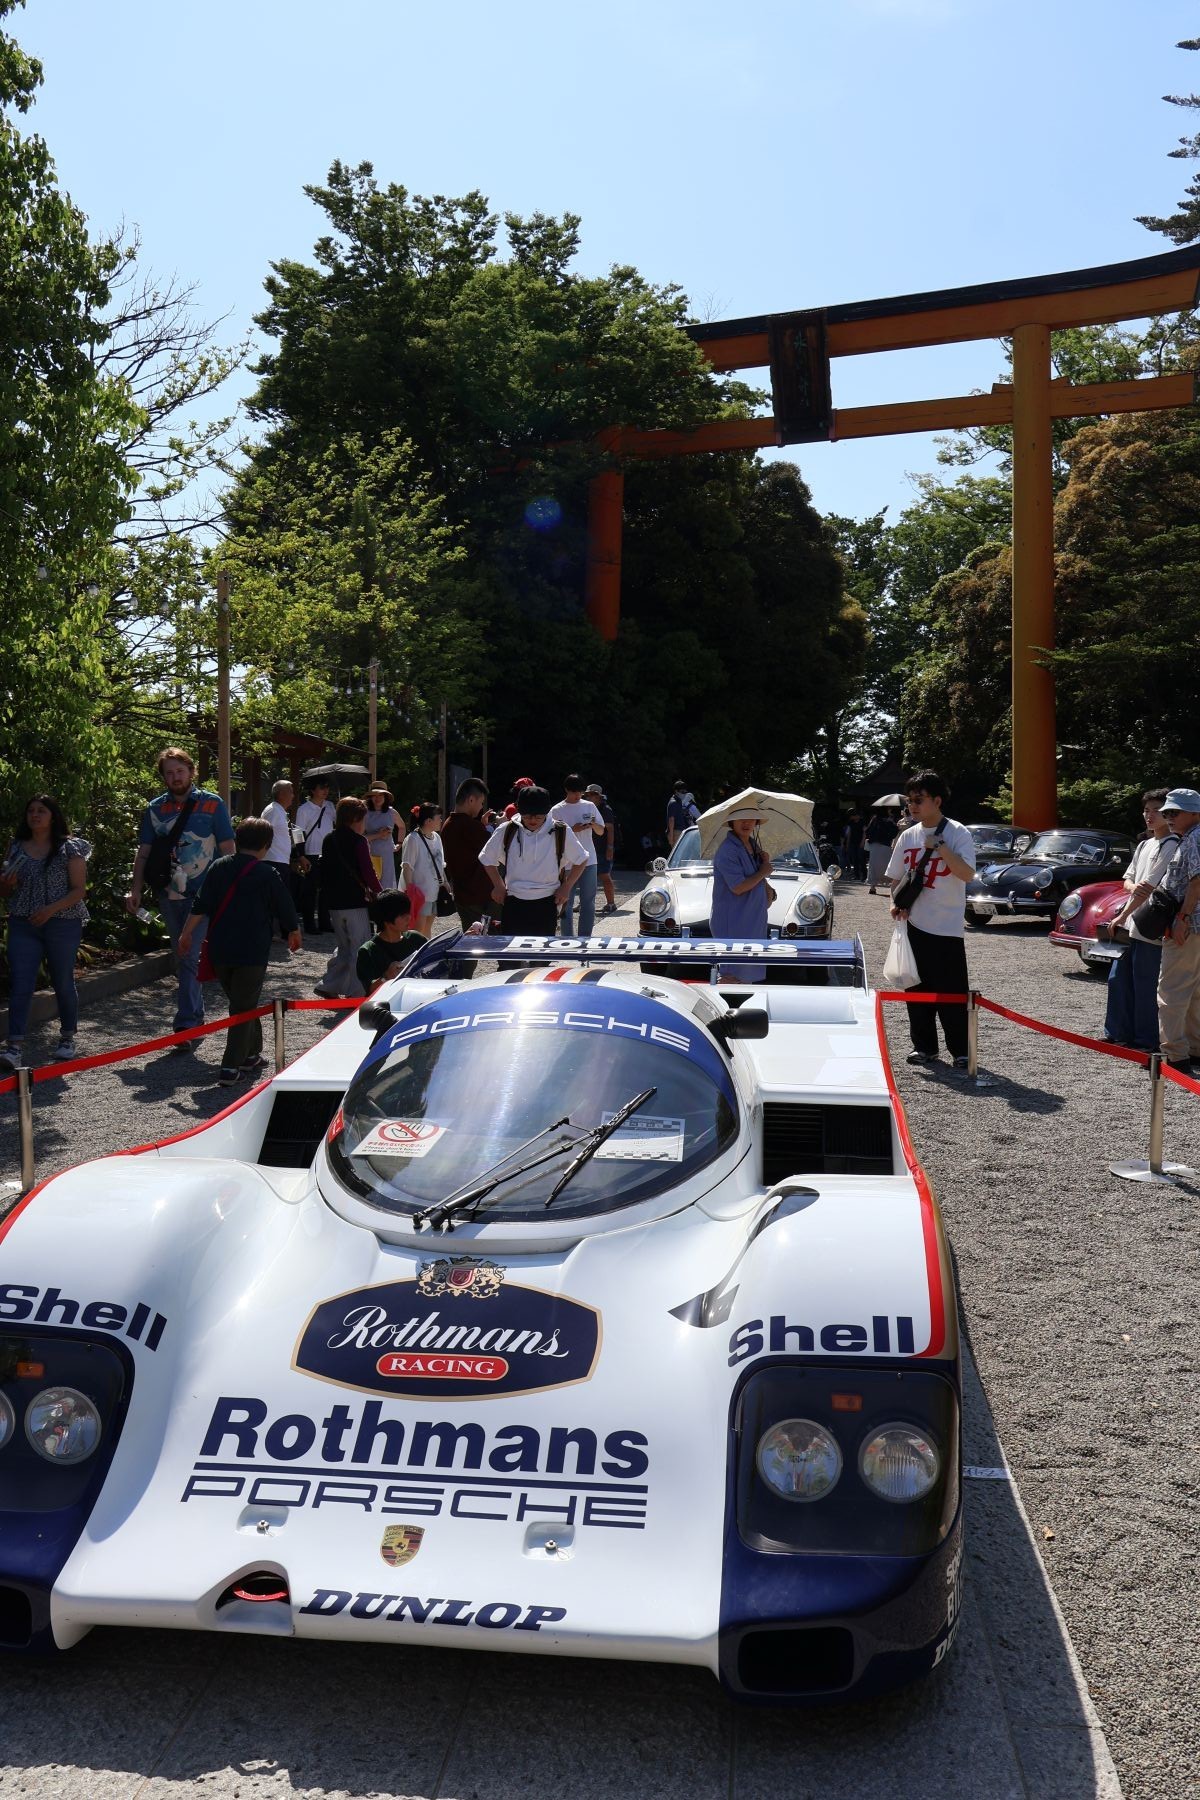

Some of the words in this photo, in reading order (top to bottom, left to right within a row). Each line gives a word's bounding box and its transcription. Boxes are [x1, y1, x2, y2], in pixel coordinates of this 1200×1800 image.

[505, 936, 799, 953] Rothmans
[389, 1011, 692, 1052] PORSCHE
[0, 1284, 167, 1352] Shell
[327, 1305, 569, 1358] Rothmans
[728, 1316, 915, 1368] Shell
[388, 1357, 496, 1375] RACING
[199, 1396, 649, 1479] Rothmans
[180, 1476, 647, 1529] PORSCHE
[301, 1588, 567, 1631] DUNLOP
